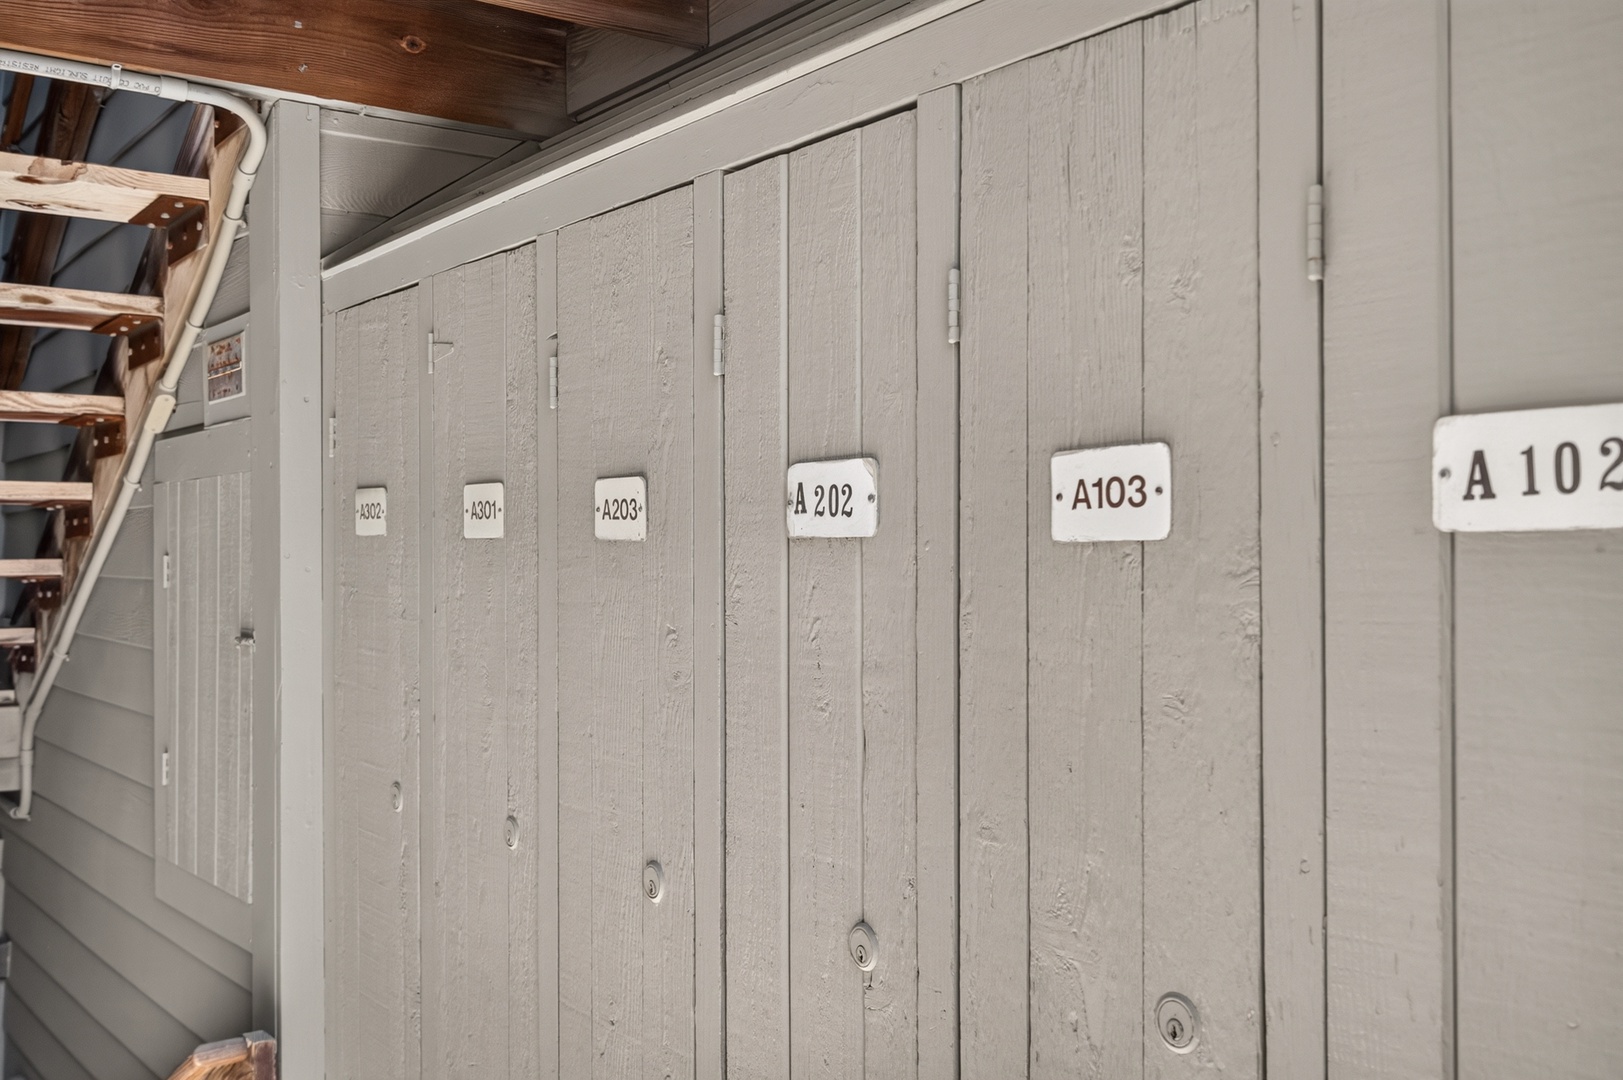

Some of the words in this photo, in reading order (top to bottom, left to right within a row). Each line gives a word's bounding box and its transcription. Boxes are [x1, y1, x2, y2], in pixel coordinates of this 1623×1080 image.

[45, 66, 89, 80] SUNLIGHT
[134, 82, 150, 91] PVC
[1462, 449, 1497, 501] A
[1519, 436, 1623, 496] 102
[793, 481, 808, 515] A
[813, 482, 854, 518] 202
[1071, 474, 1148, 511] A103
[359, 502, 382, 520] A302
[470, 499, 498, 520] A301
[601, 497, 639, 521] A203
